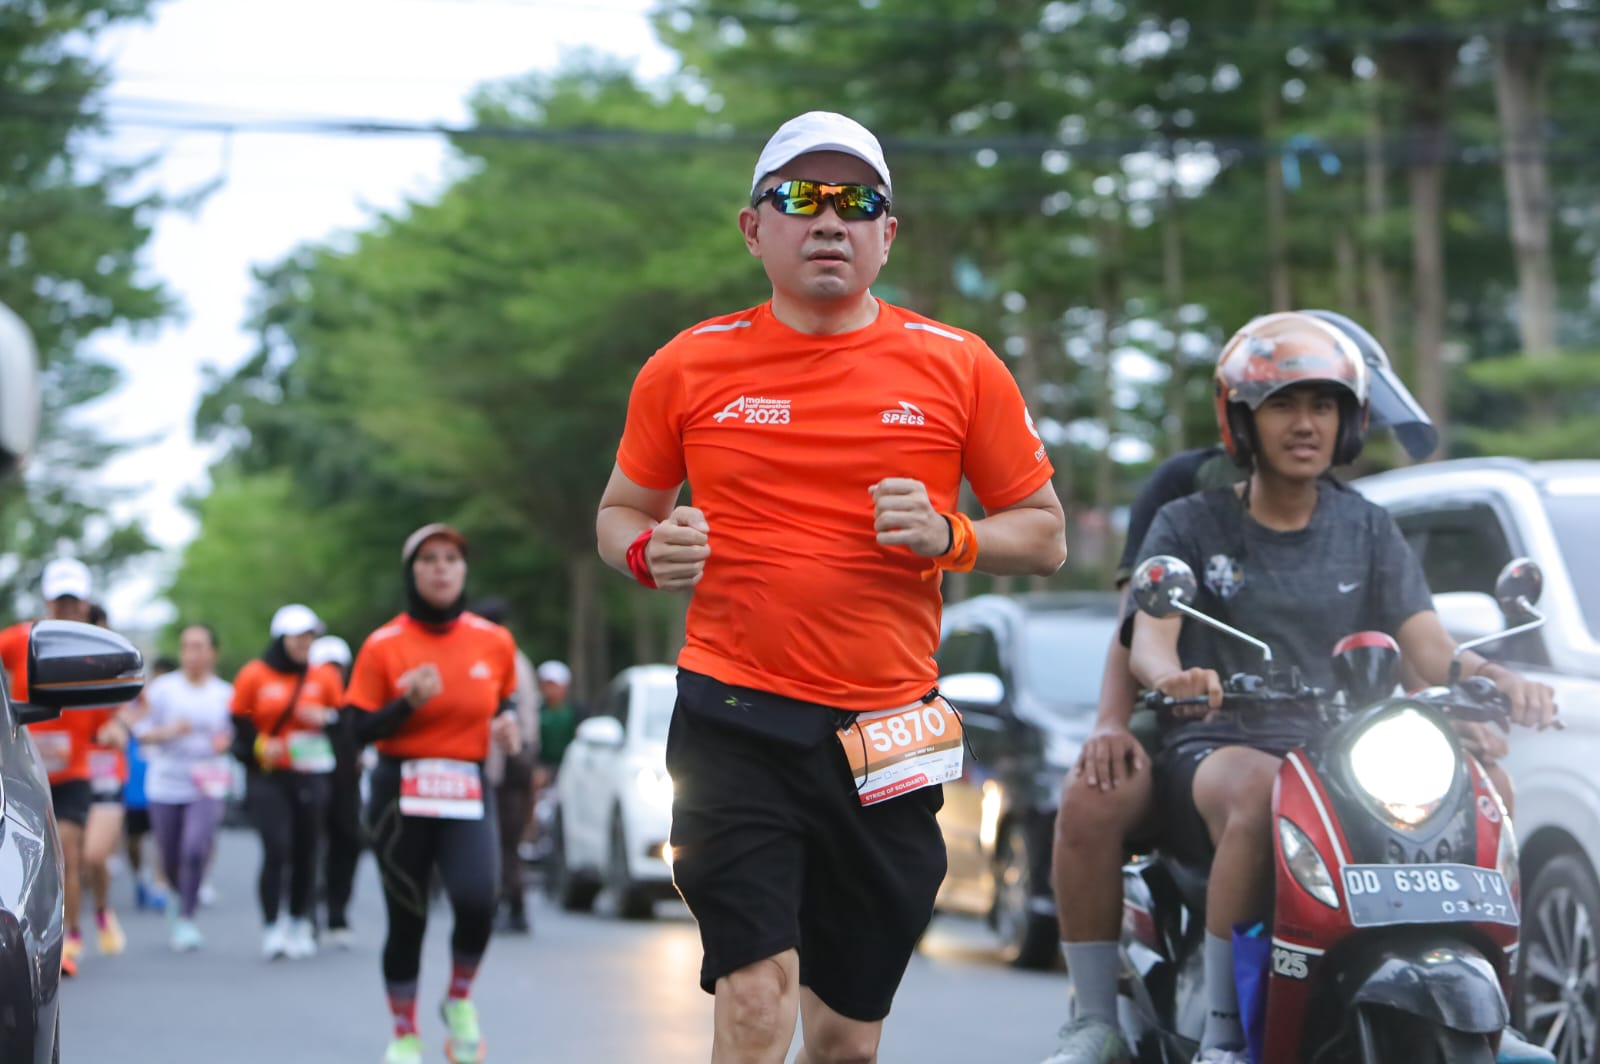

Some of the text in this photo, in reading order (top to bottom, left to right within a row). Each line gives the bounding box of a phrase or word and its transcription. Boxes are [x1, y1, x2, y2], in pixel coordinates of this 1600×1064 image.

[745, 396, 791, 404] makassar
[745, 409, 790, 424] 2023
[881, 413, 925, 426] SPECS
[865, 707, 946, 752] 5870
[1346, 870, 1503, 896] DD 6386 YV
[1272, 948, 1309, 979] 125
